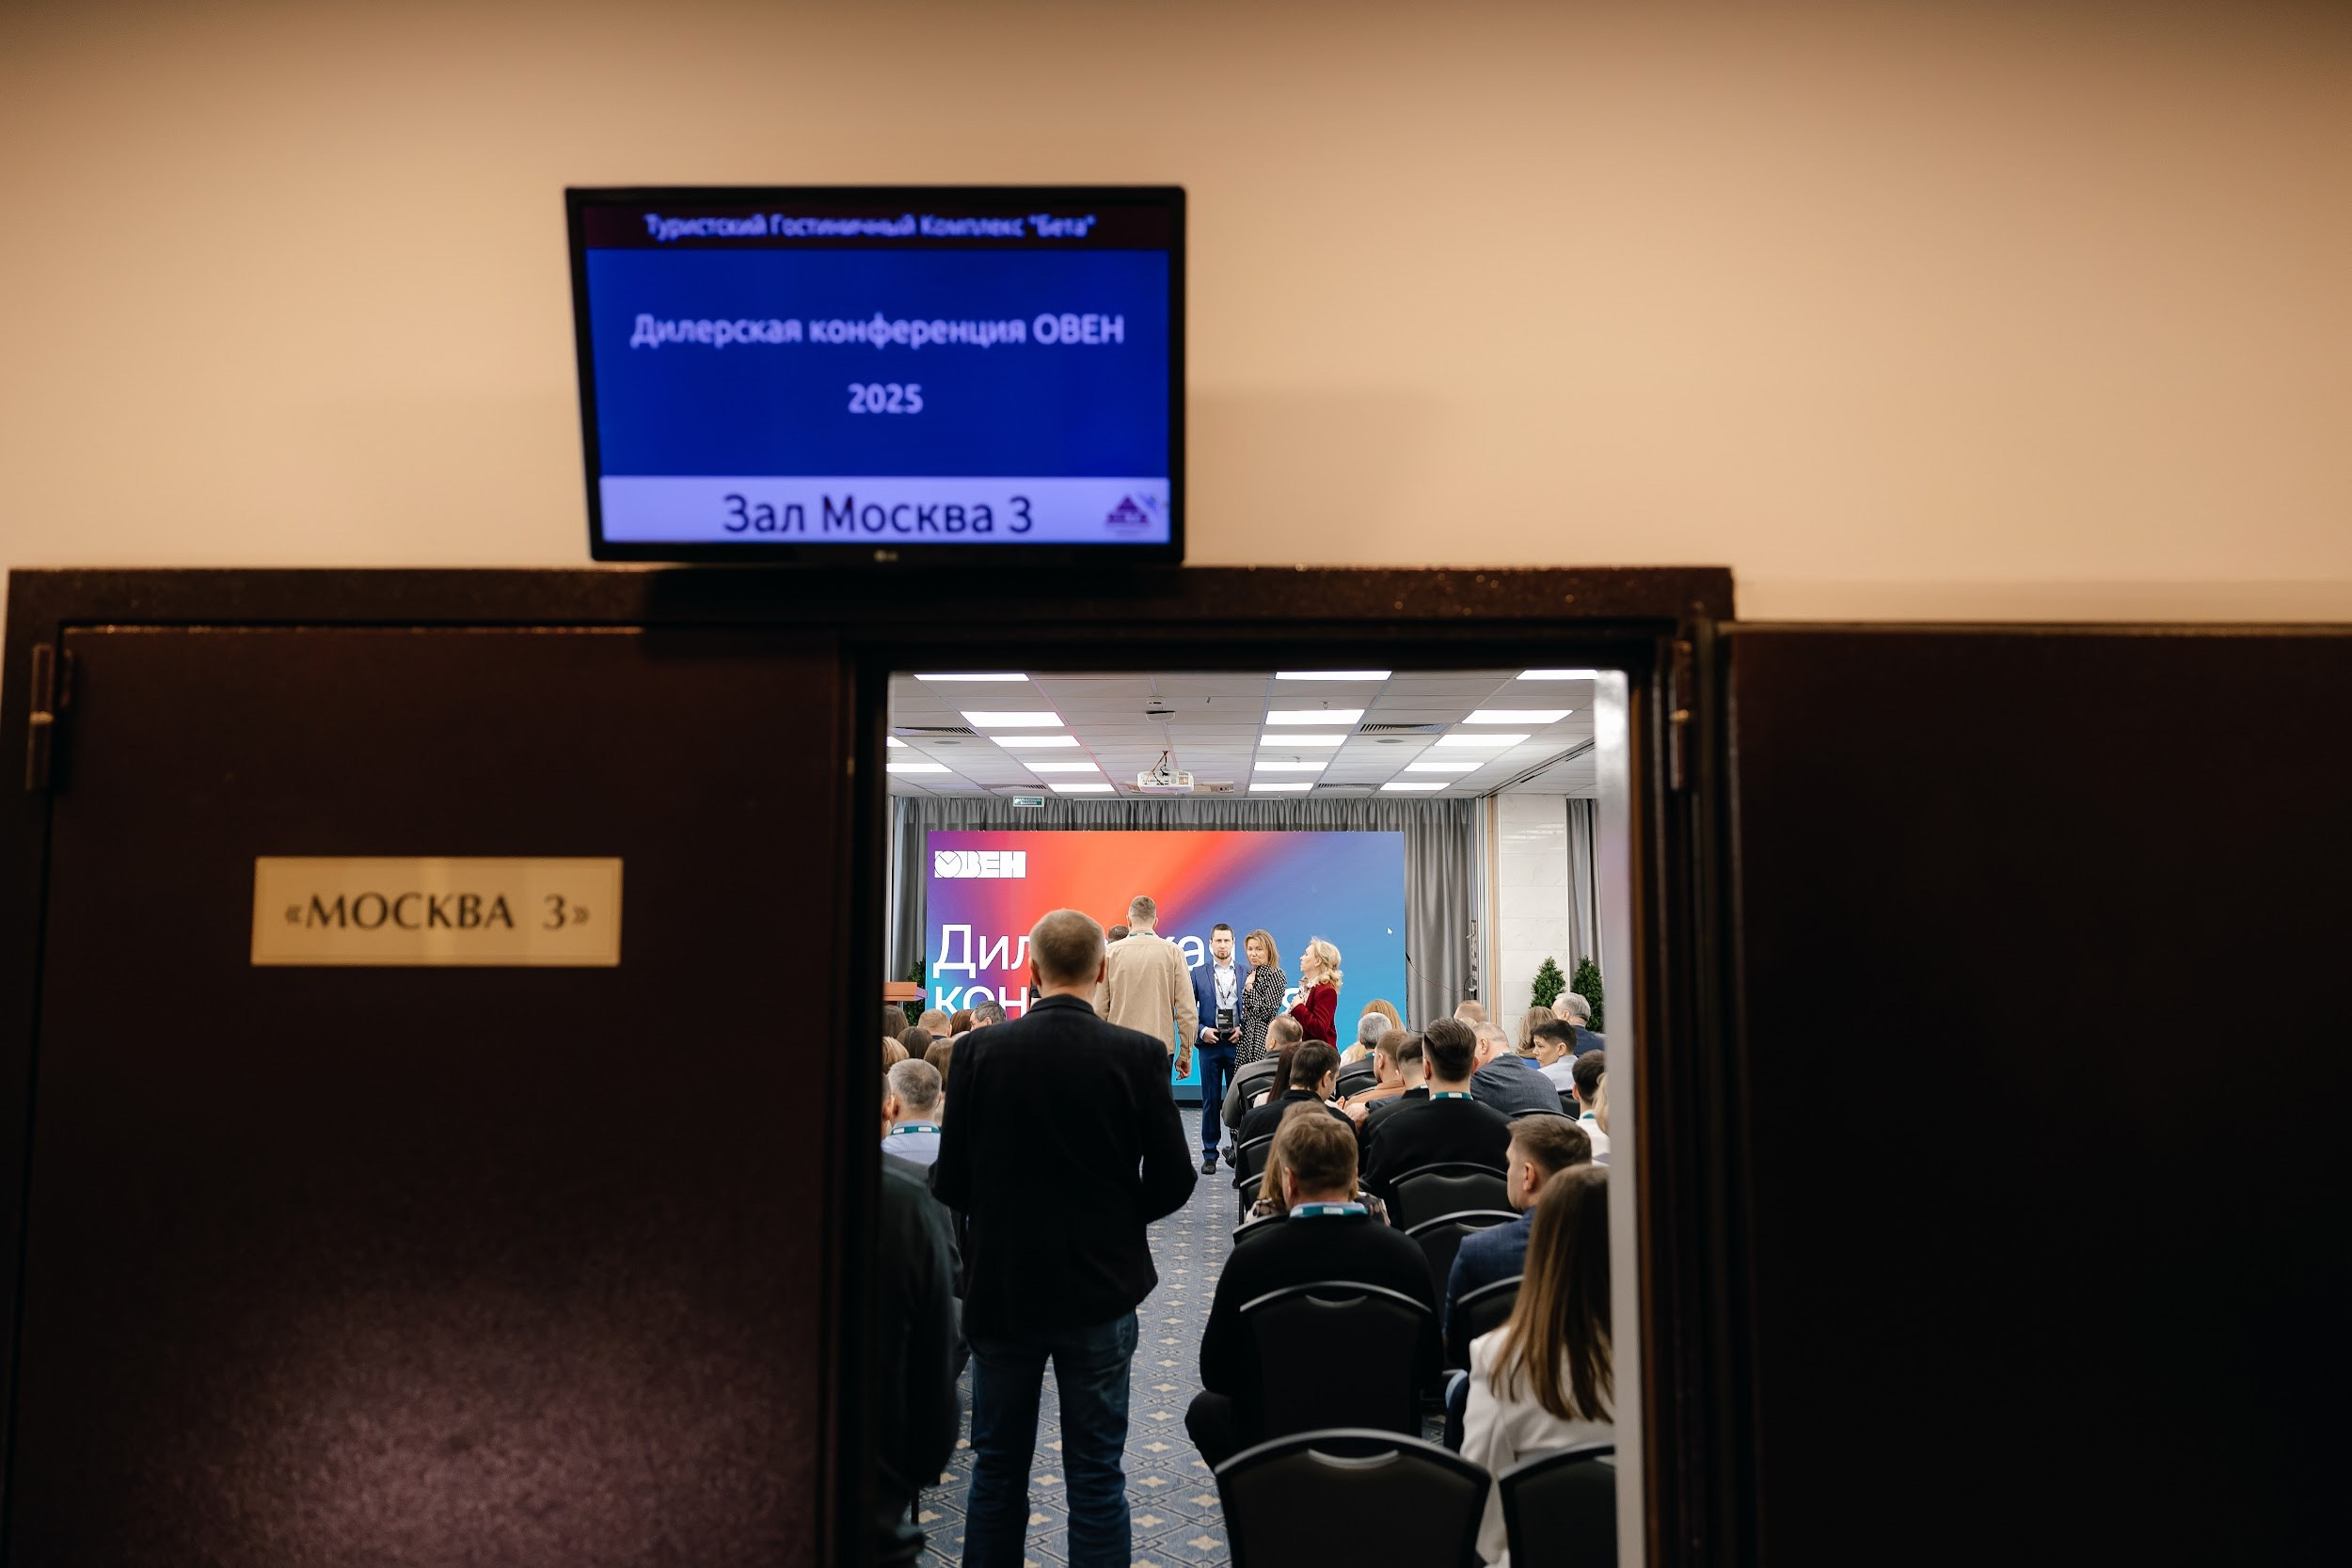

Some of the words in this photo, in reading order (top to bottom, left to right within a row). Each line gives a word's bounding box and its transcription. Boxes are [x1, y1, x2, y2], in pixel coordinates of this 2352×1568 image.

[630, 313, 803, 349] Дилерская
[809, 312, 1026, 349] конференция
[1034, 314, 1124, 344] ОВЕН
[848, 383, 923, 414] 2025
[723, 494, 806, 533] Зал
[821, 495, 993, 533] Москва
[1009, 497, 1033, 533] 3
[285, 893, 516, 930] «МОСКВА
